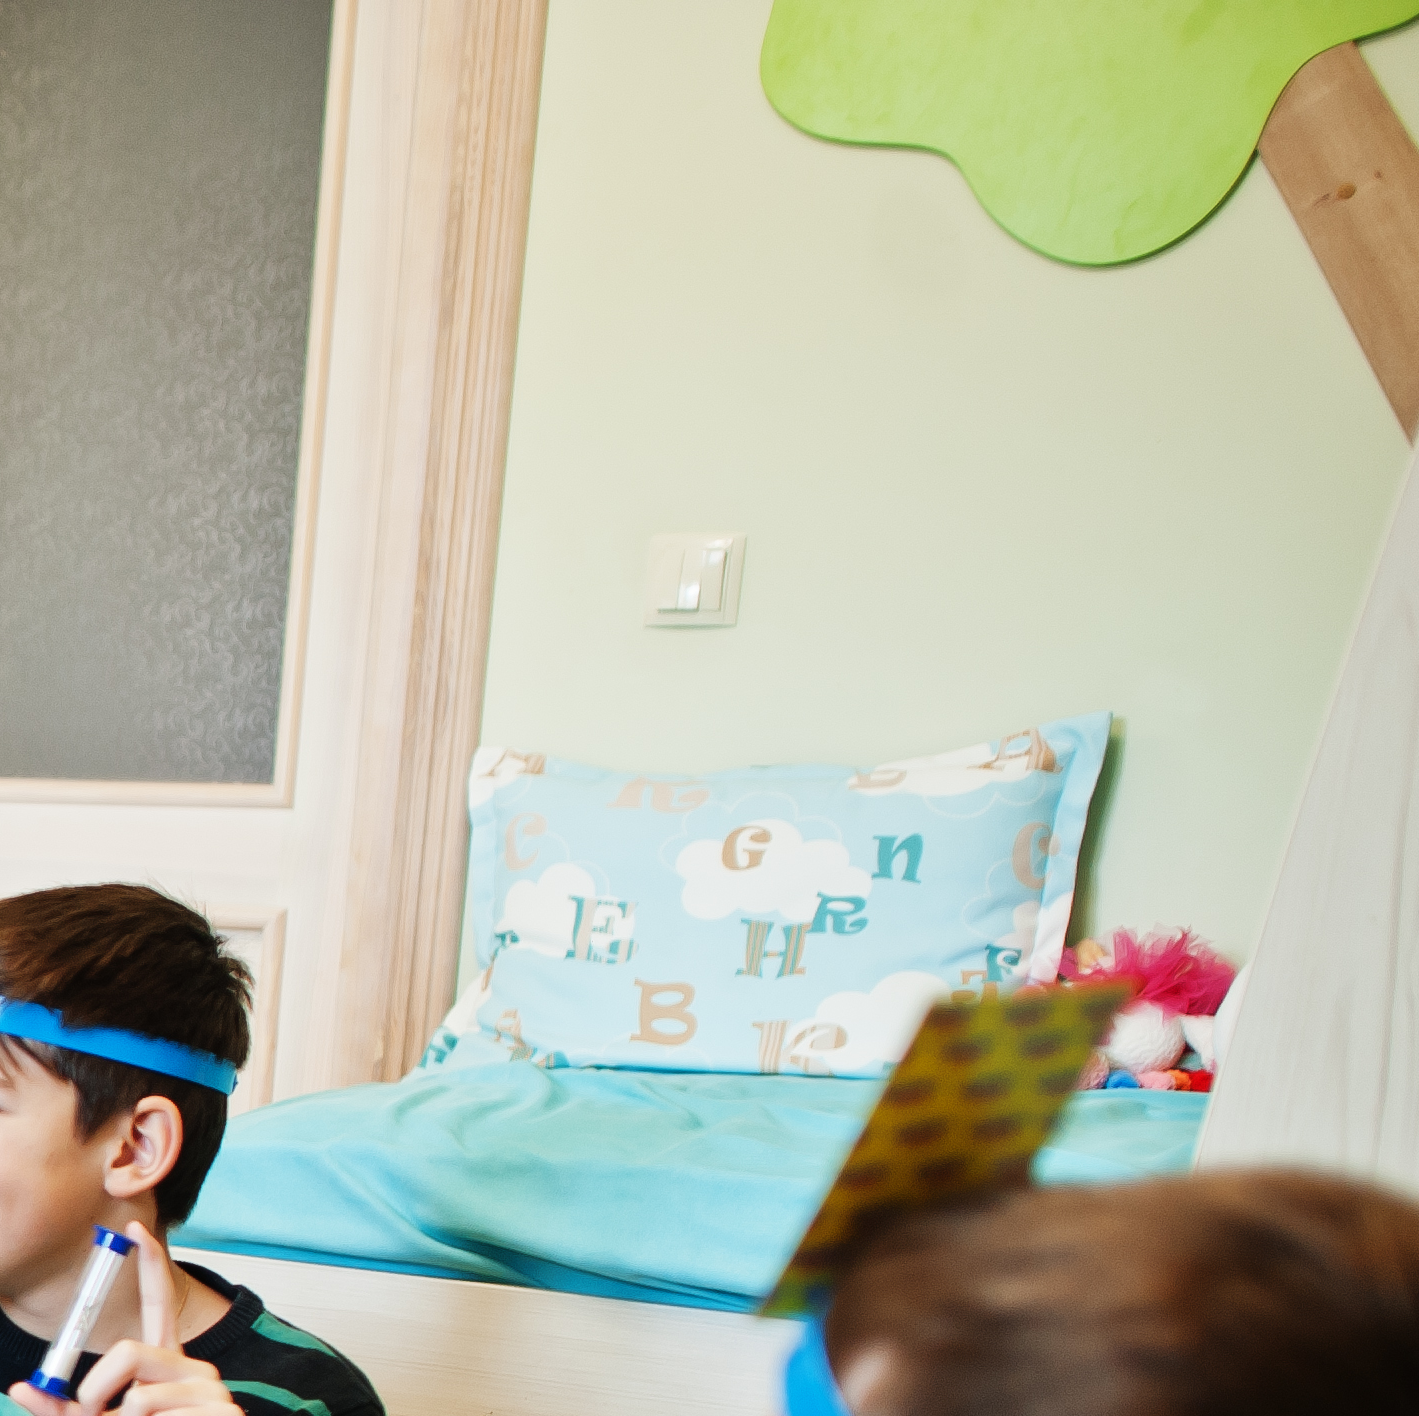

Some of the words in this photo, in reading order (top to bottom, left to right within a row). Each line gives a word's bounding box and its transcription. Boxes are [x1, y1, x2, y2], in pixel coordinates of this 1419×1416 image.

[721, 825, 772, 871] G
[806, 891, 869, 935] R
[629, 977, 699, 1046] B
